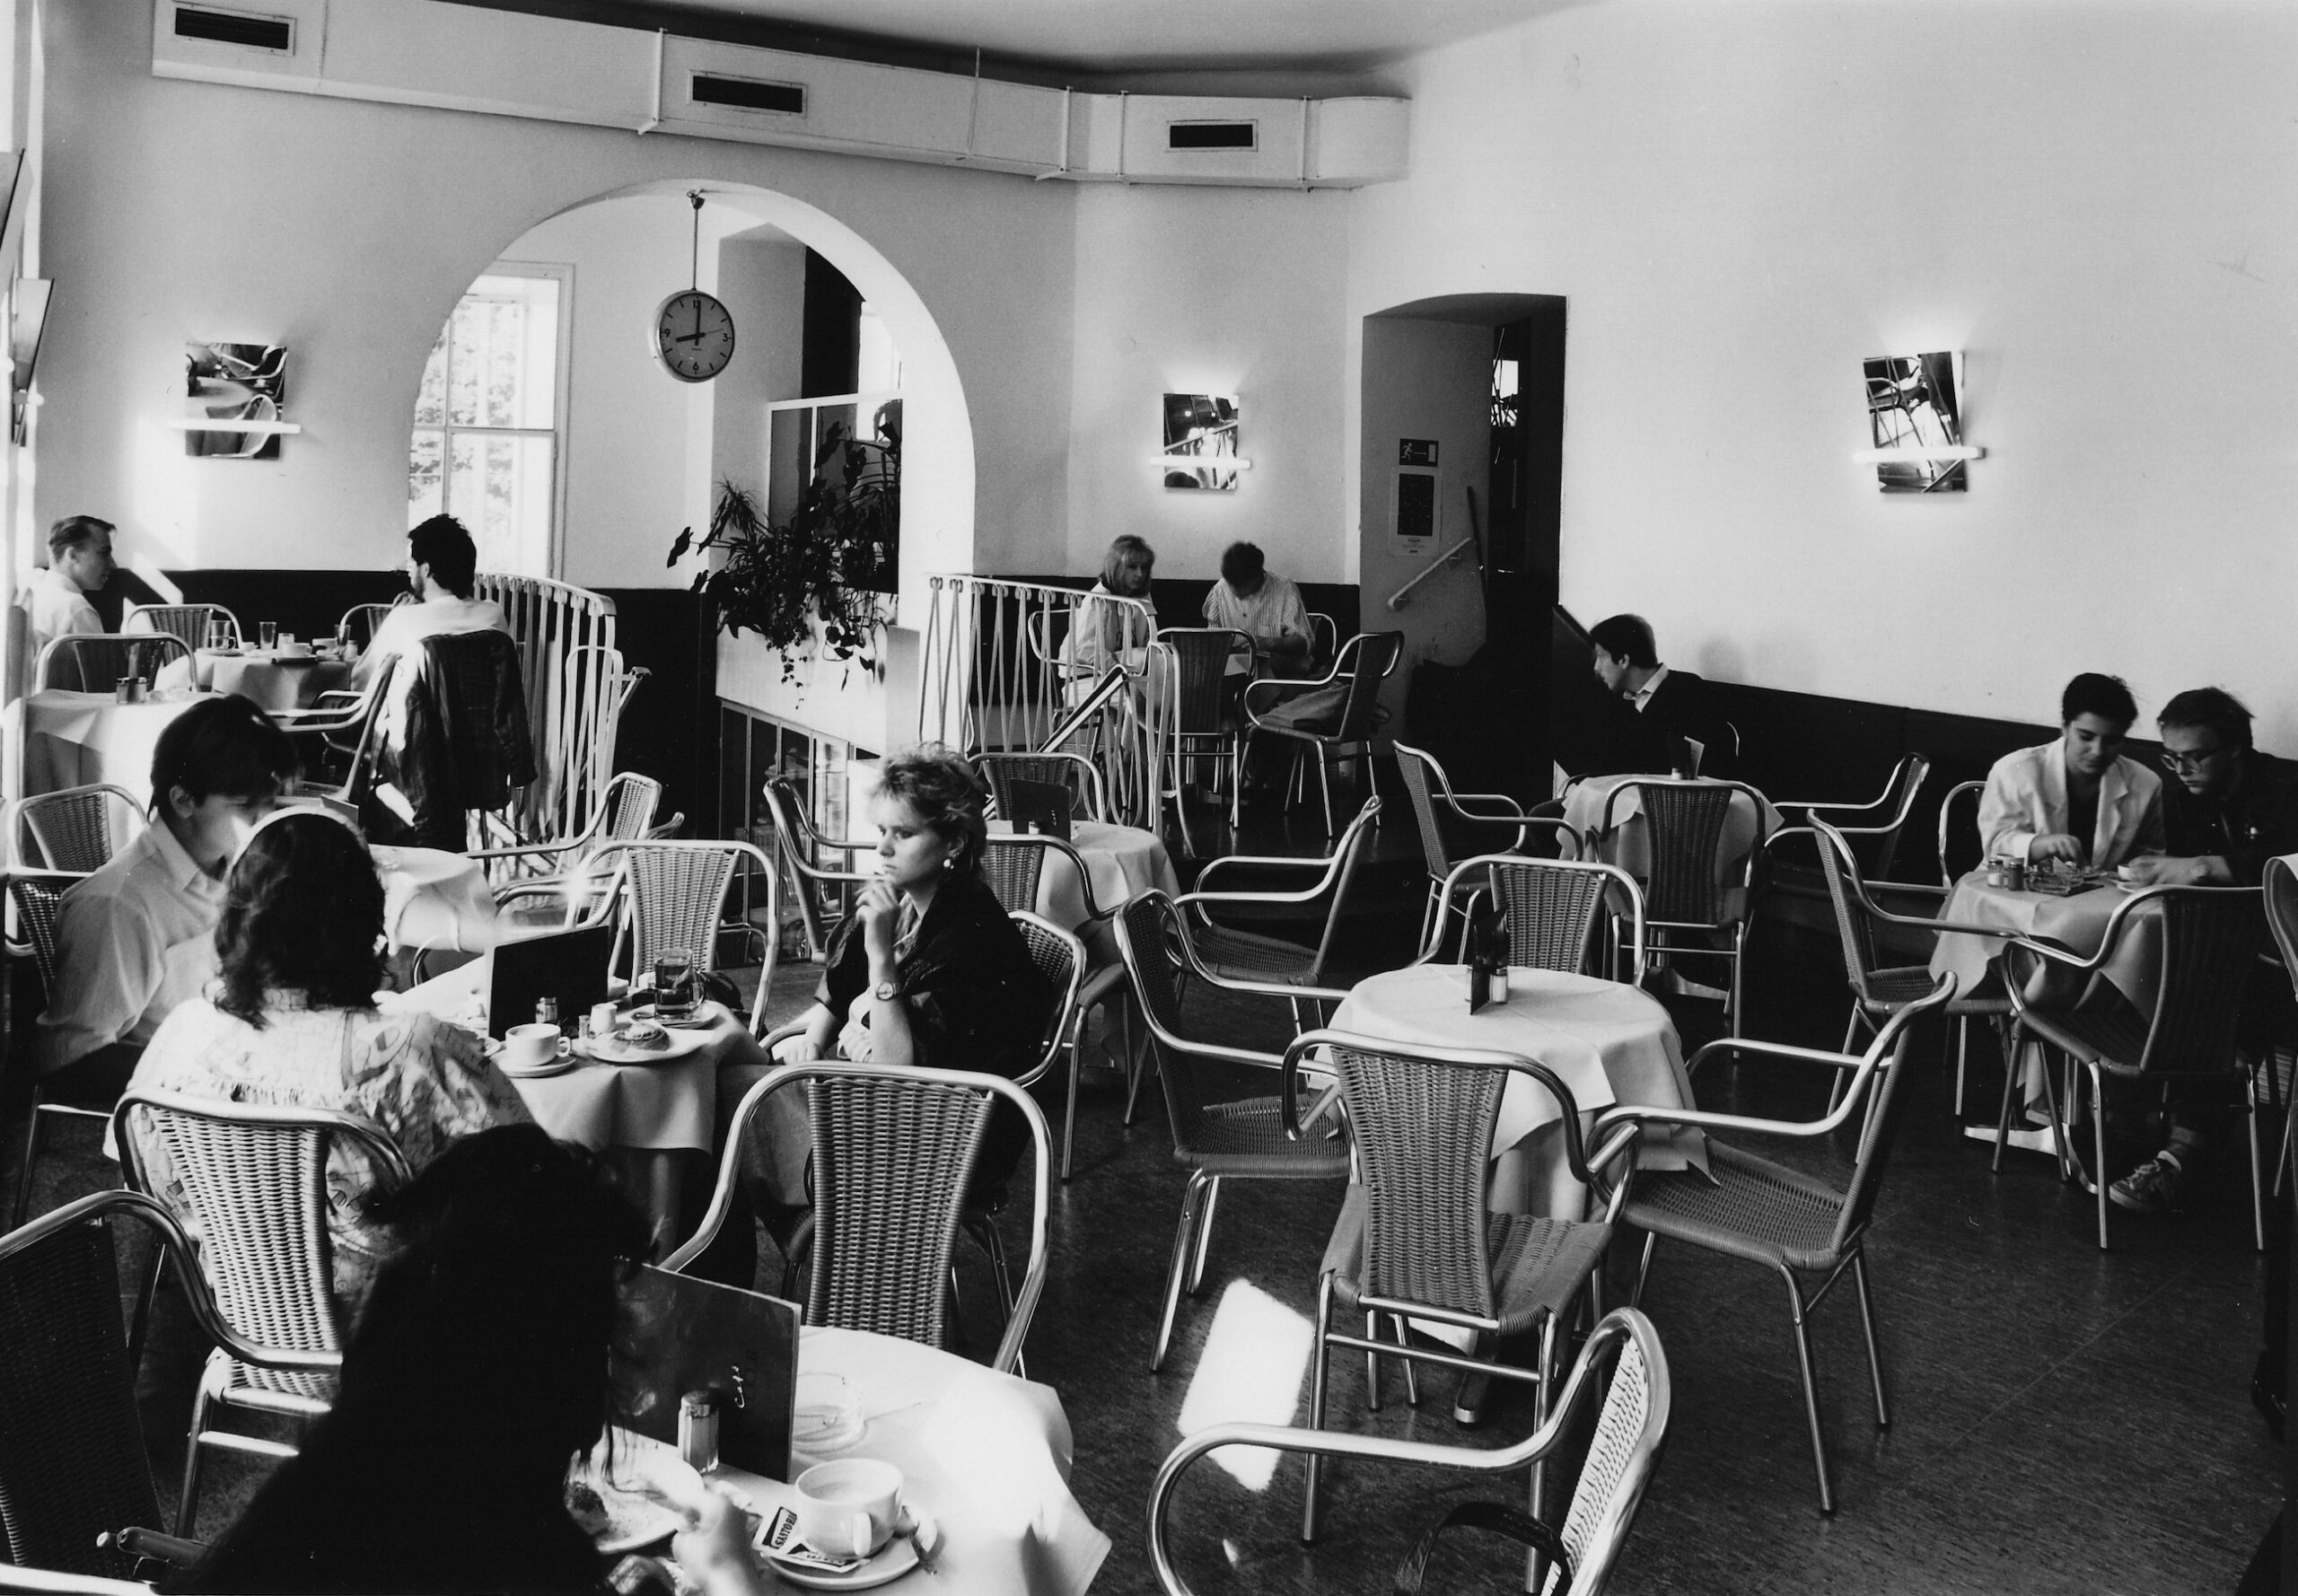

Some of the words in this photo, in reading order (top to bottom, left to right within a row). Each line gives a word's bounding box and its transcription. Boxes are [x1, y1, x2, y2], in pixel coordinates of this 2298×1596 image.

[663, 328, 671, 338] 9
[722, 332, 729, 343] 3
[692, 361, 699, 372] 6
